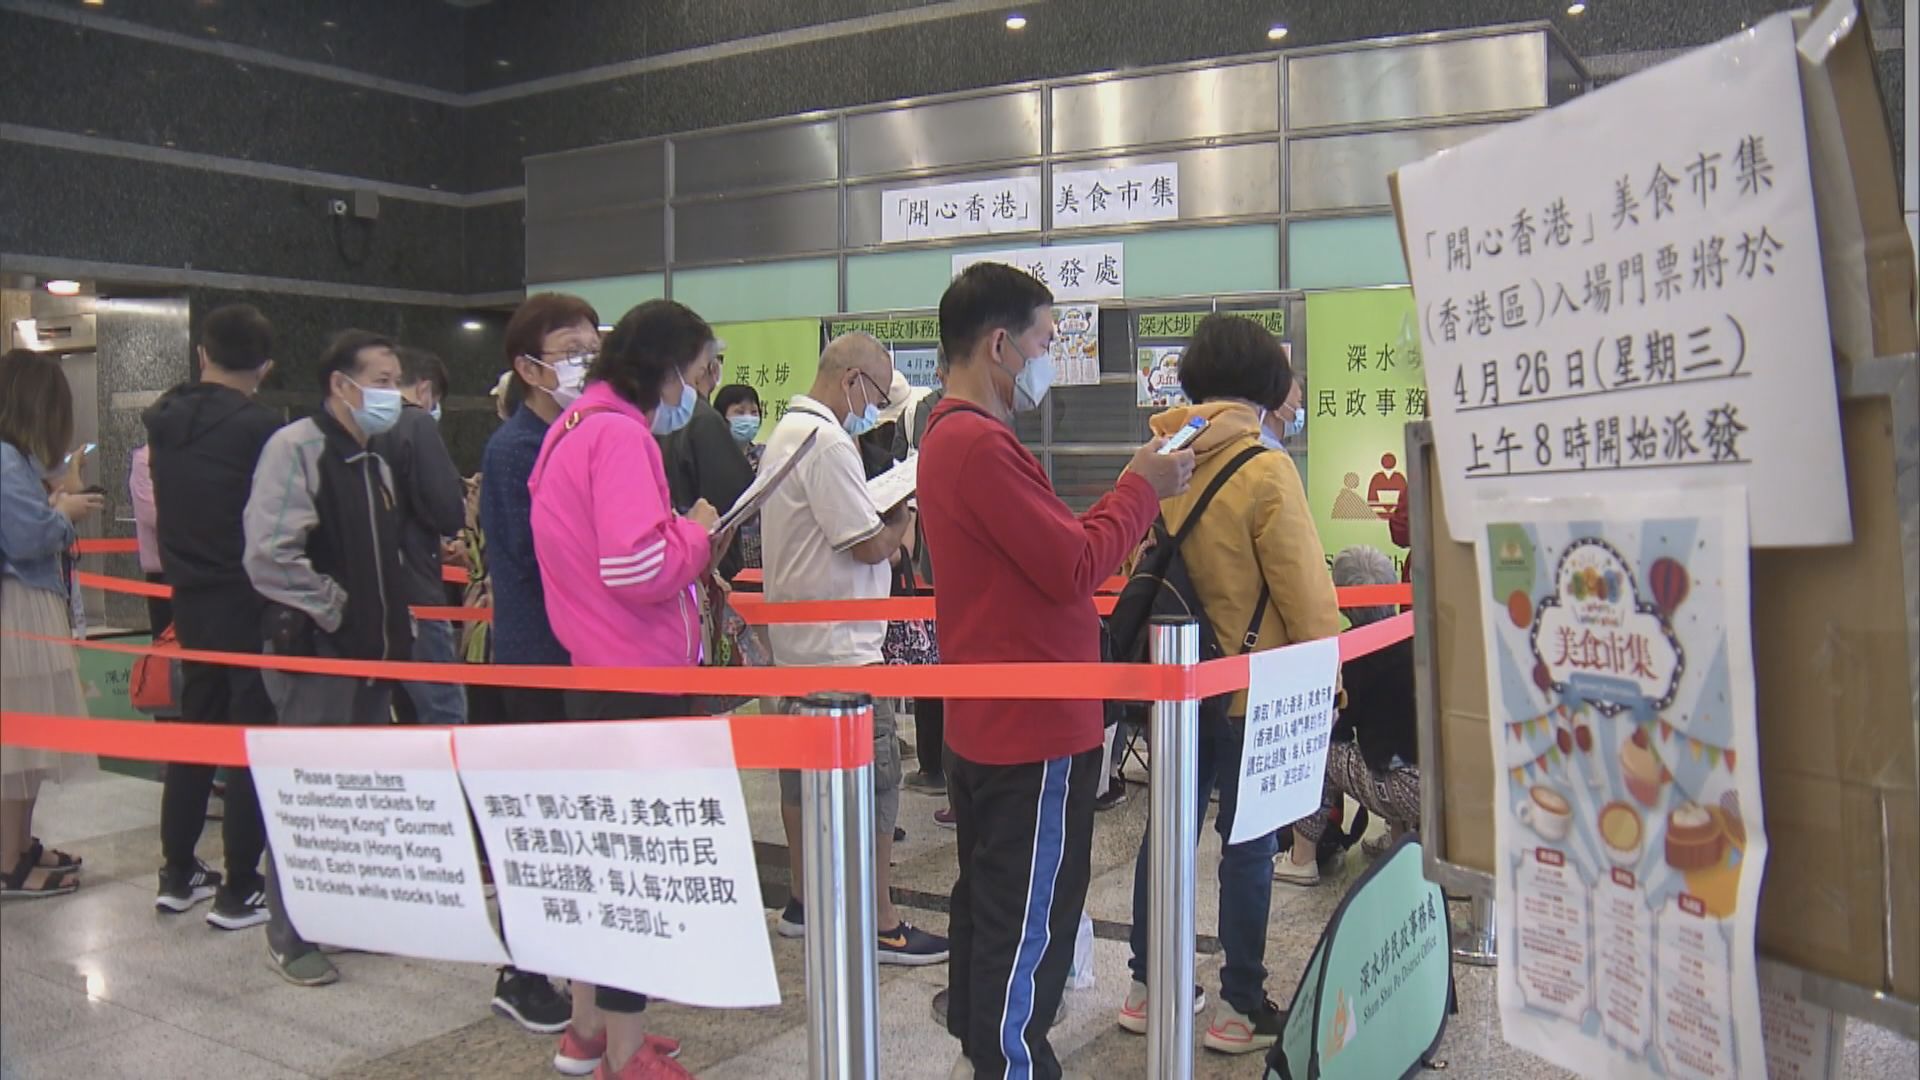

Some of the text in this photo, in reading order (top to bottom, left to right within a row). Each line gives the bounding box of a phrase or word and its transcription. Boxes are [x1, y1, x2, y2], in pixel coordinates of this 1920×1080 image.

[897, 175, 1175, 227] 「開心香港」 美食市集
[1425, 134, 1775, 272] 「開心香港」美食市集
[1425, 226, 1783, 345] (香港區)入場門票將於
[294, 768, 405, 788] Please queue here
[278, 790, 436, 811] for collection of tickets for
[317, 814, 349, 834] Hong
[395, 818, 454, 836] Gourmet
[293, 834, 442, 863] Marketplace (Hong Kong
[326, 858, 354, 875] Each
[359, 863, 400, 882] person
[404, 865, 416, 880] is
[419, 866, 465, 884] limited
[293, 877, 465, 908] to 2 tickets while stocks last.
